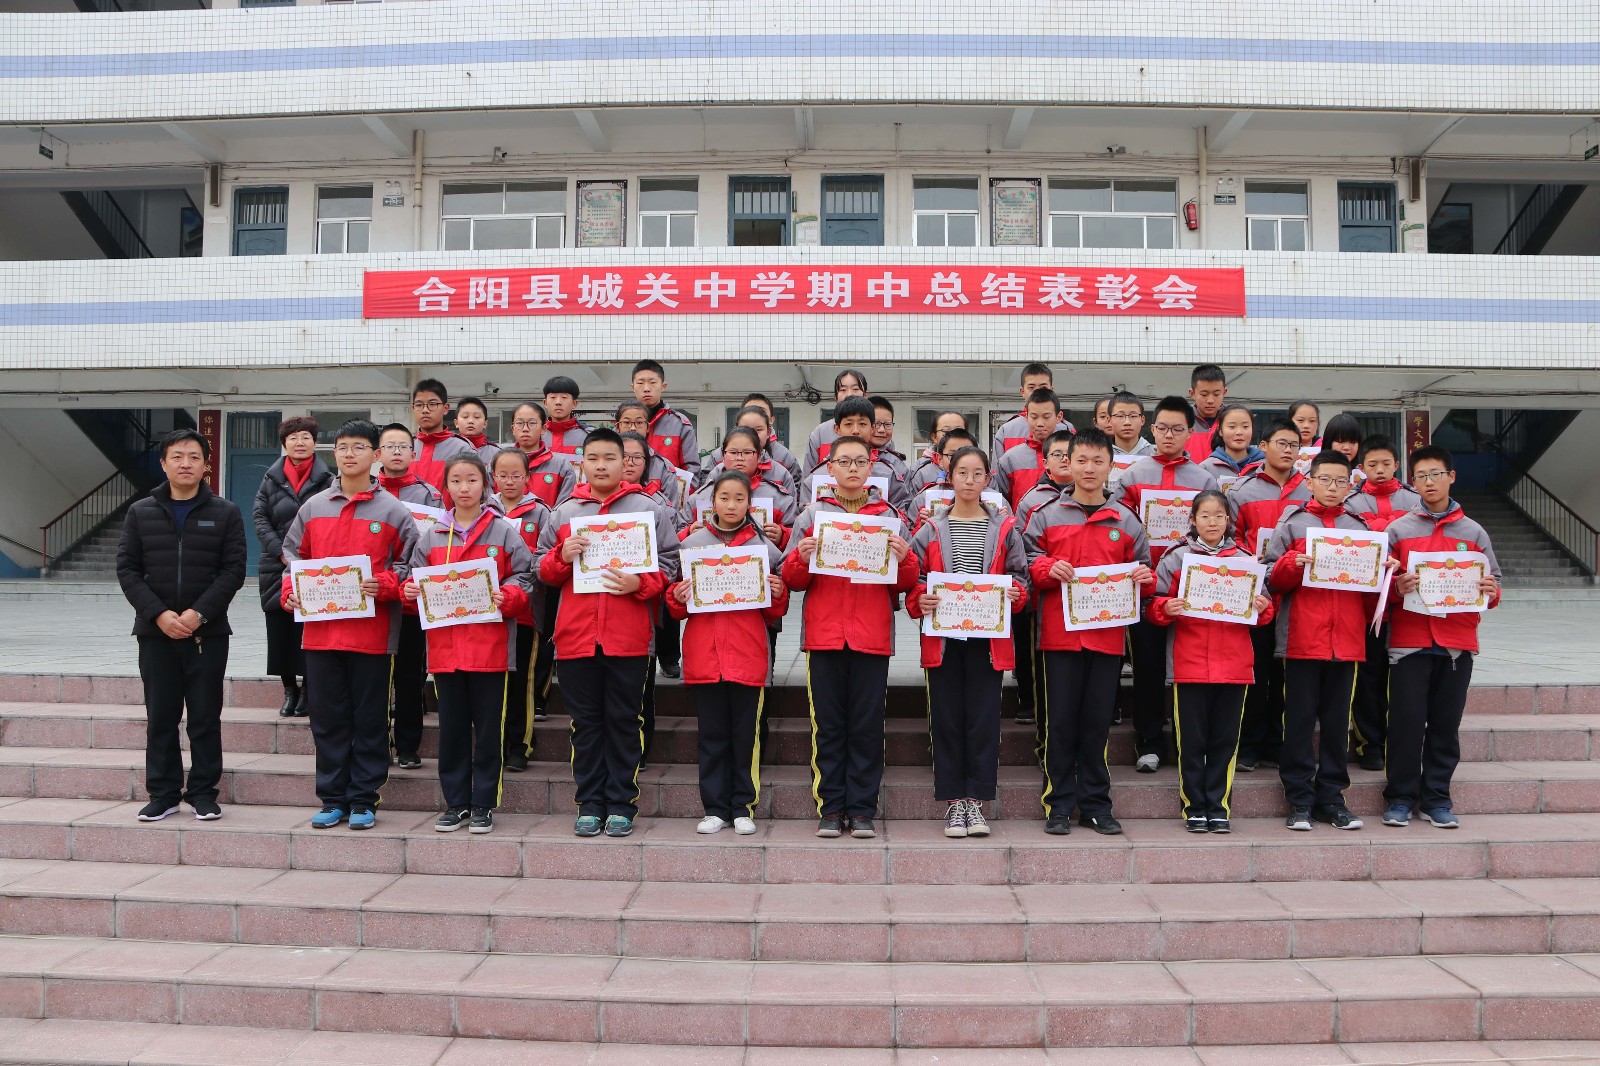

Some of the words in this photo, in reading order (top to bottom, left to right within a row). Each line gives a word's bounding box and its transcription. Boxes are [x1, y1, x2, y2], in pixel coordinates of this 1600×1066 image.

[412, 271, 1198, 312] 合阳县城关中学期中总结表彰会
[601, 533, 627, 541] 奖状
[842, 533, 869, 543] 奖状
[1334, 548, 1360, 557] 奖状
[714, 567, 741, 576] 奖状
[316, 578, 340, 586] 奖状
[1209, 577, 1234, 586] 奖状
[443, 582, 469, 592] 奖状
[955, 594, 982, 602] 奖状
